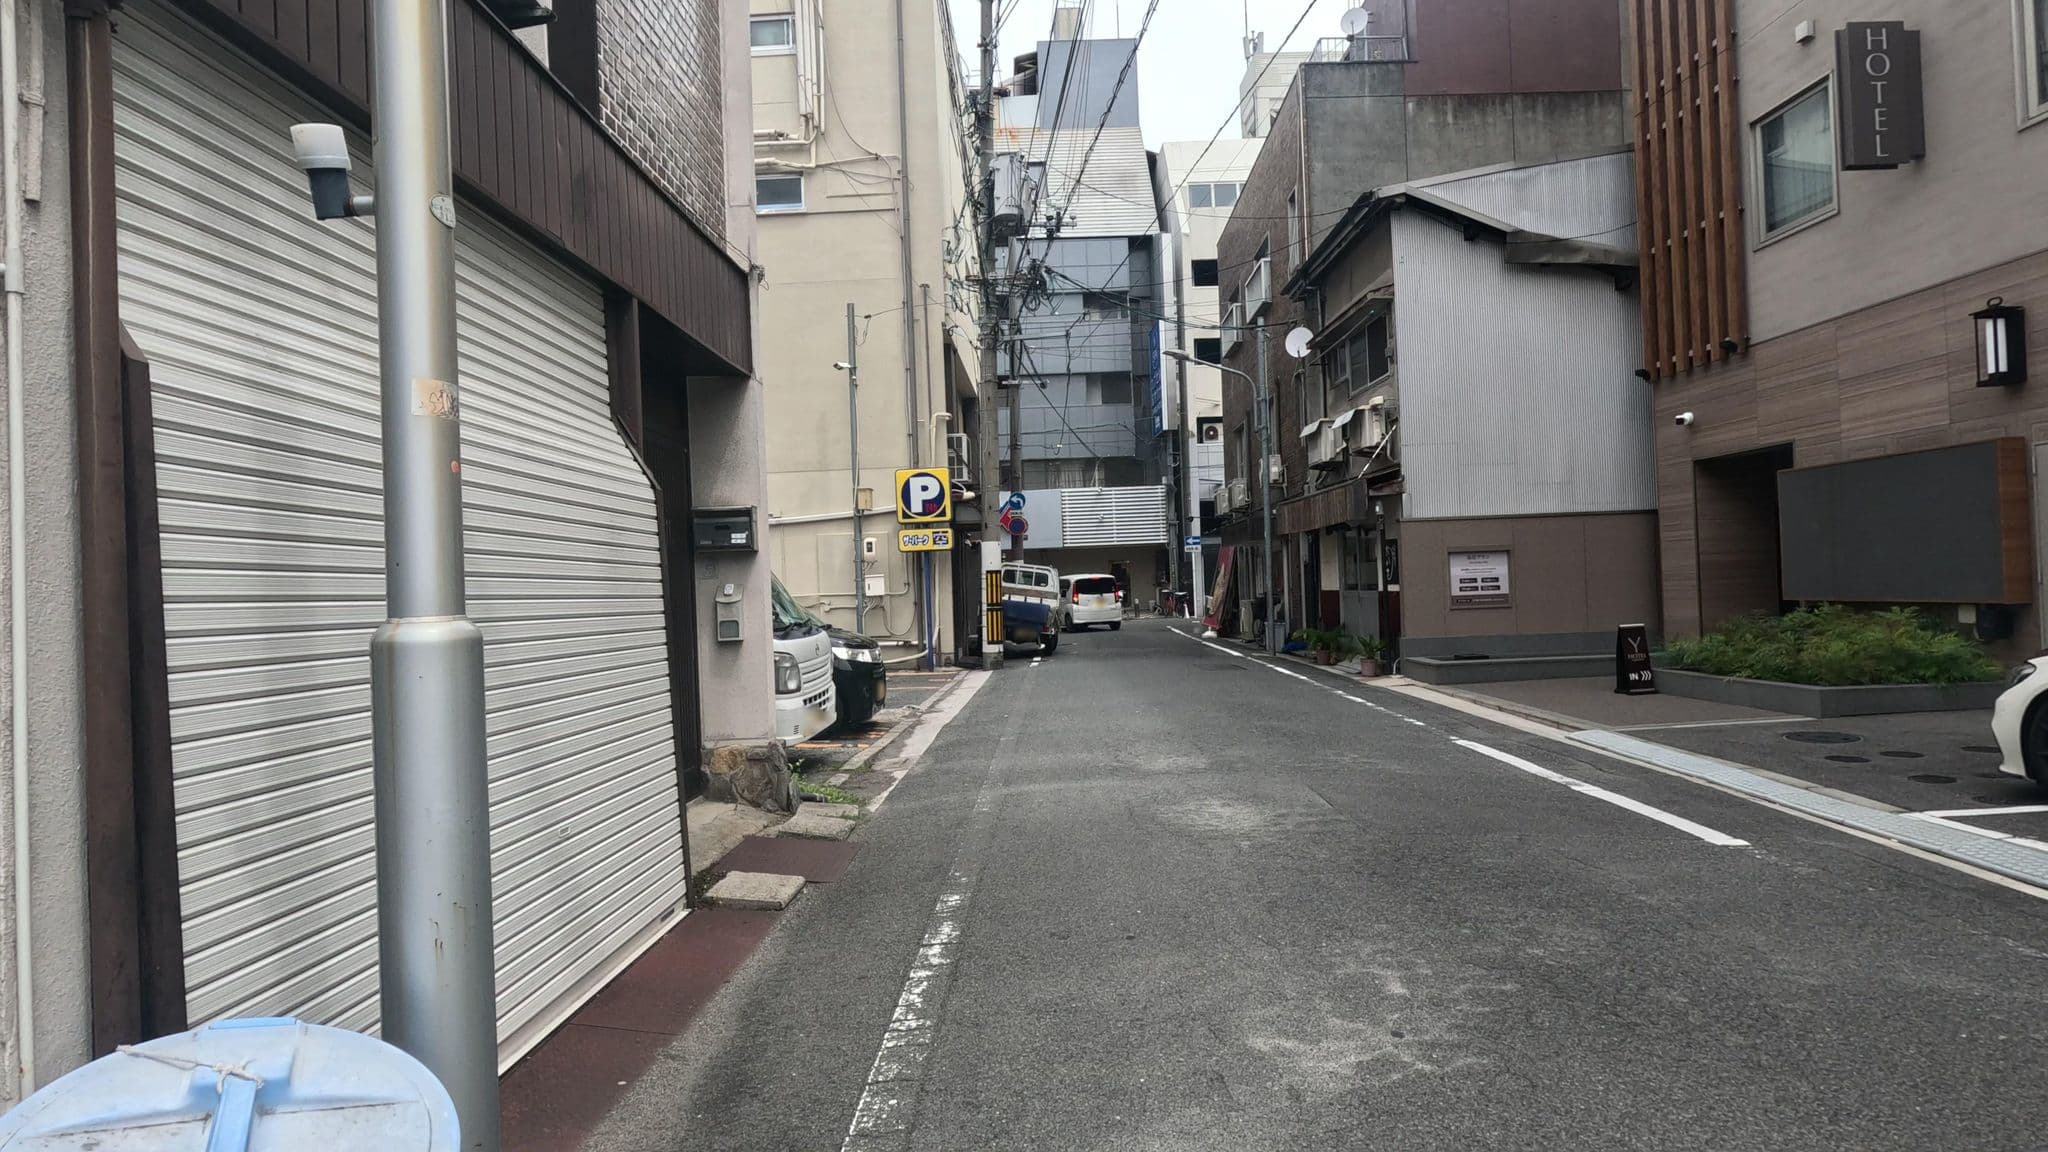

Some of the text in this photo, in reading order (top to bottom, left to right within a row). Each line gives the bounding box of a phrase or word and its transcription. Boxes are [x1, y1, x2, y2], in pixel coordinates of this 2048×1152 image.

[1866, 28, 1890, 157] HOTEL
[909, 476, 940, 513] P
[933, 531, 949, 546] 空
[1627, 636, 1641, 653] Y
